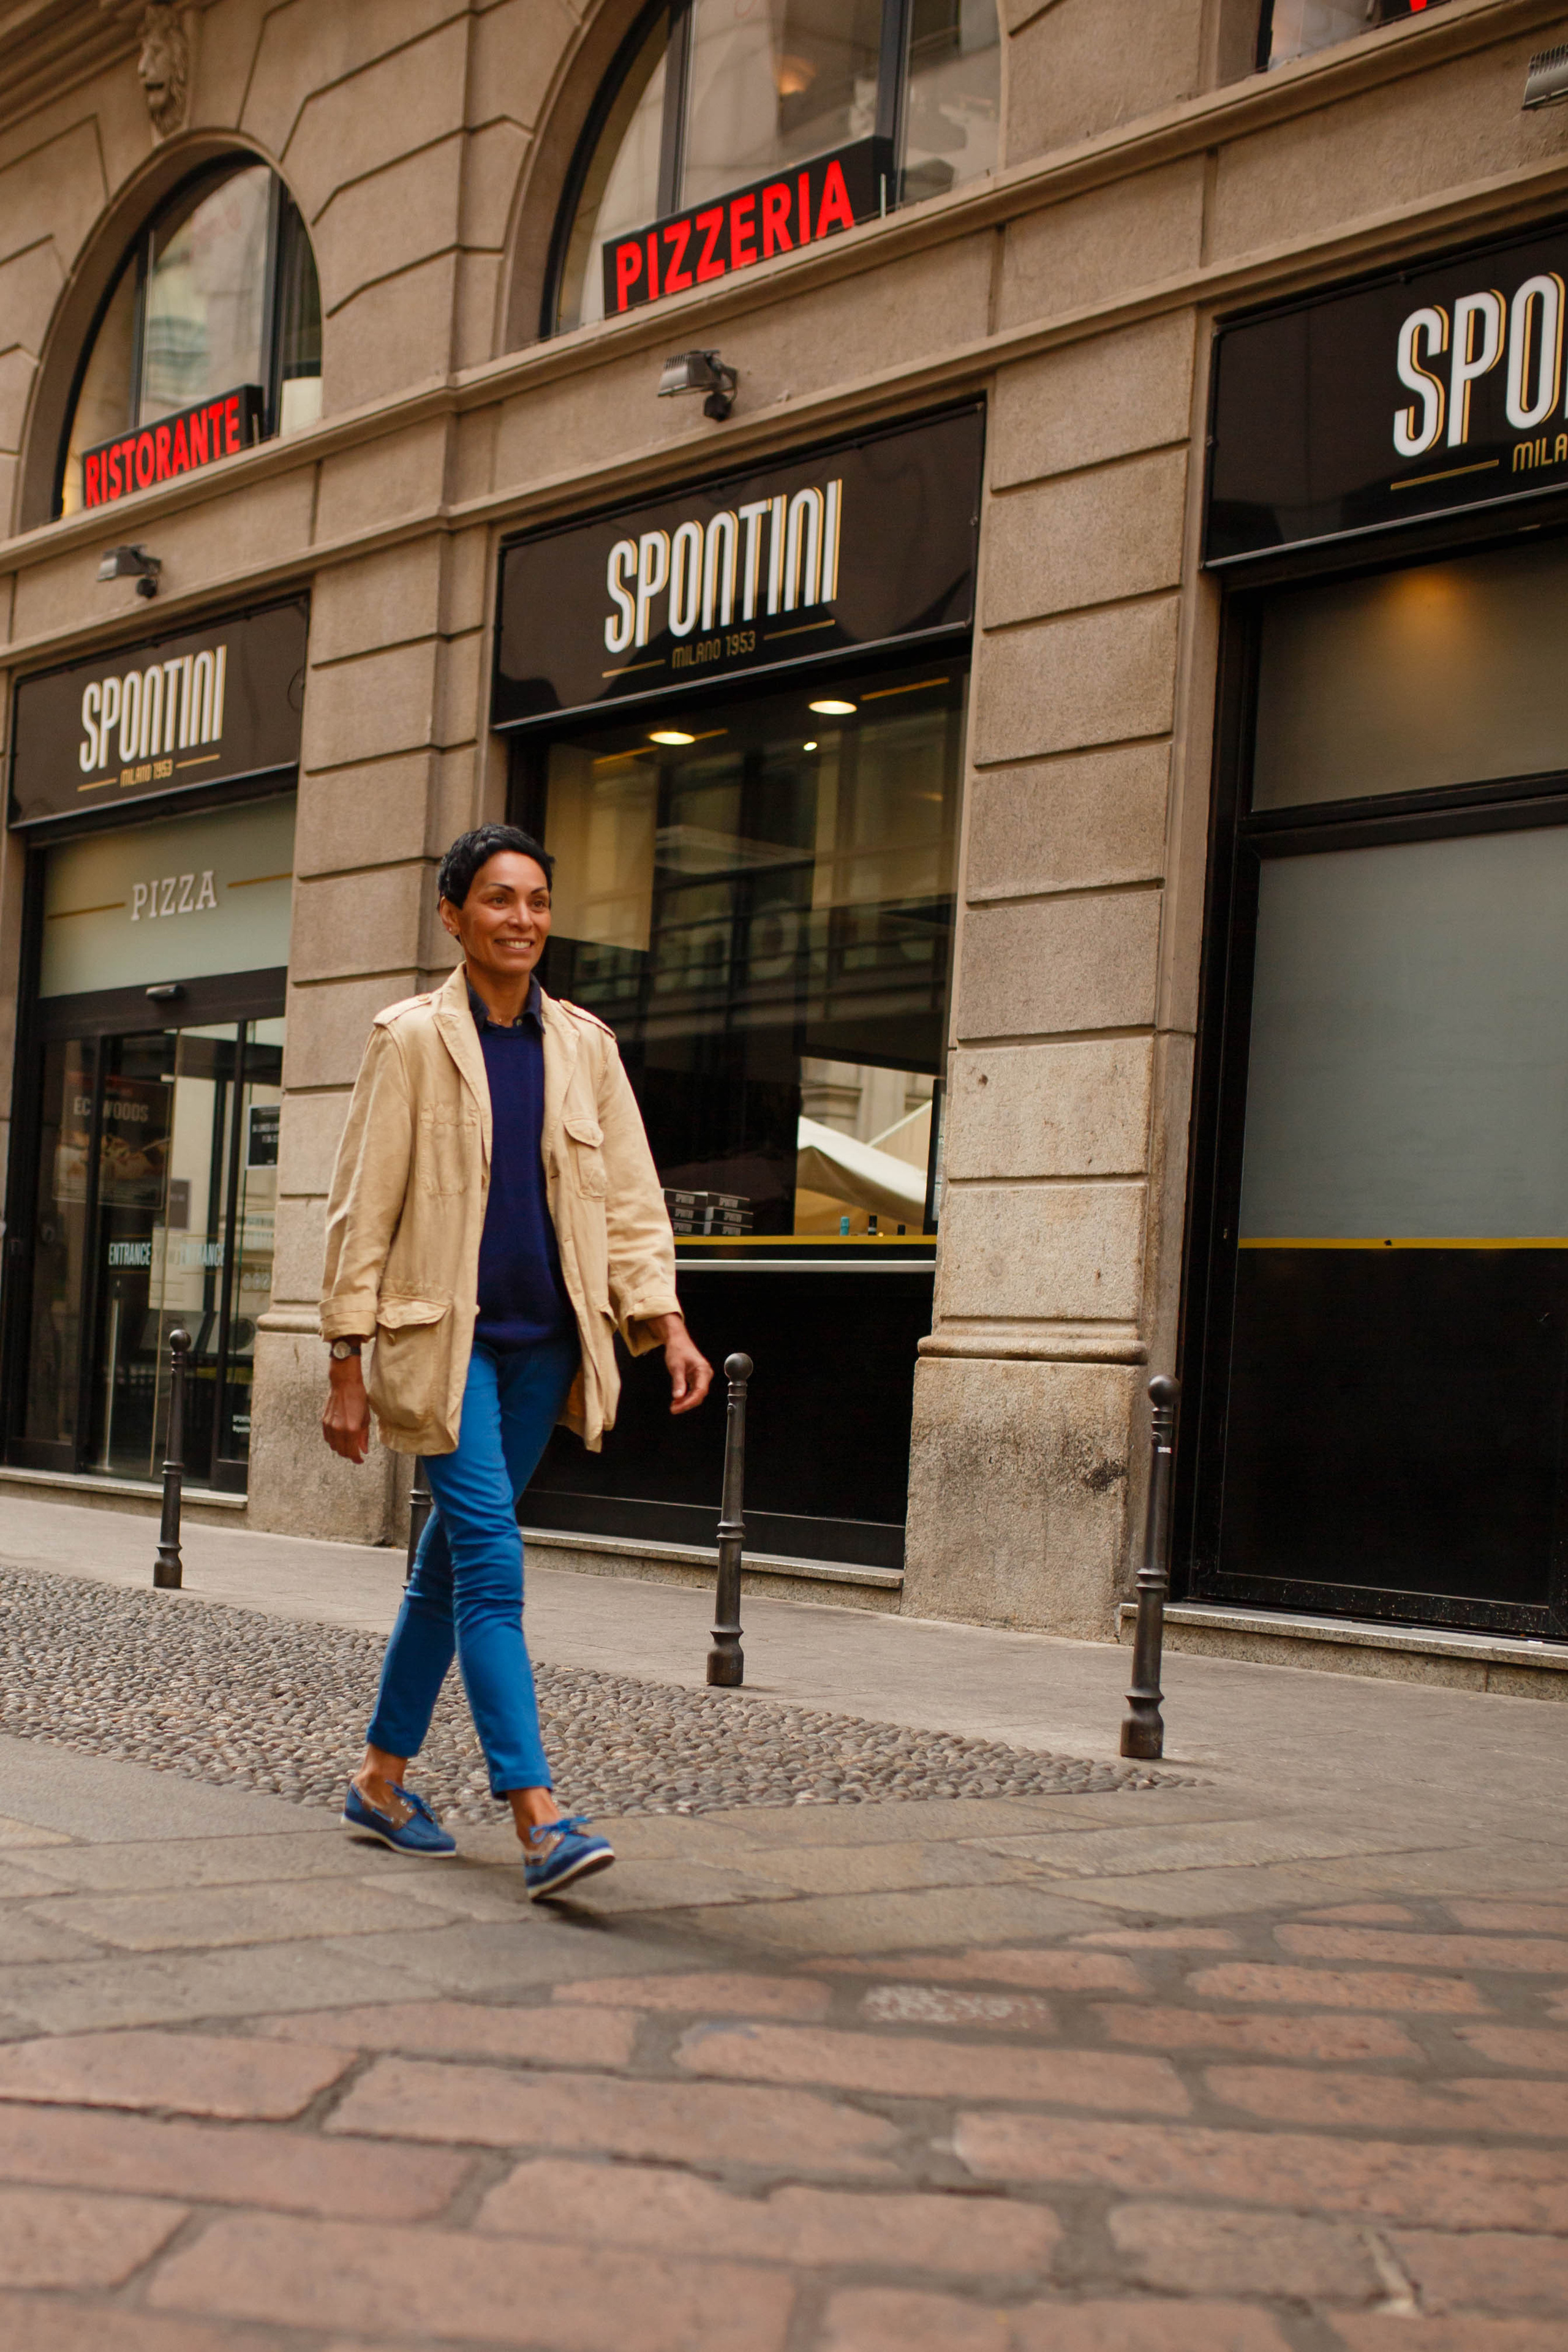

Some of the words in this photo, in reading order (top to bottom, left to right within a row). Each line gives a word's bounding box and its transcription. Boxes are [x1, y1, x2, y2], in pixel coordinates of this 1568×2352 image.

[616, 159, 855, 312] PIZZERIA
[1393, 271, 1568, 457] SPO
[85, 395, 241, 509] RISTORANTE
[604, 478, 843, 654] SPONTINI
[672, 638, 722, 669] MILANO
[726, 630, 756, 657] 1953
[79, 644, 227, 773] SPONTINI
[119, 763, 152, 788] MILANO
[153, 758, 173, 780] 1953
[130, 870, 217, 921] PIZZA
[108, 1242, 152, 1266] ENTRANCE
